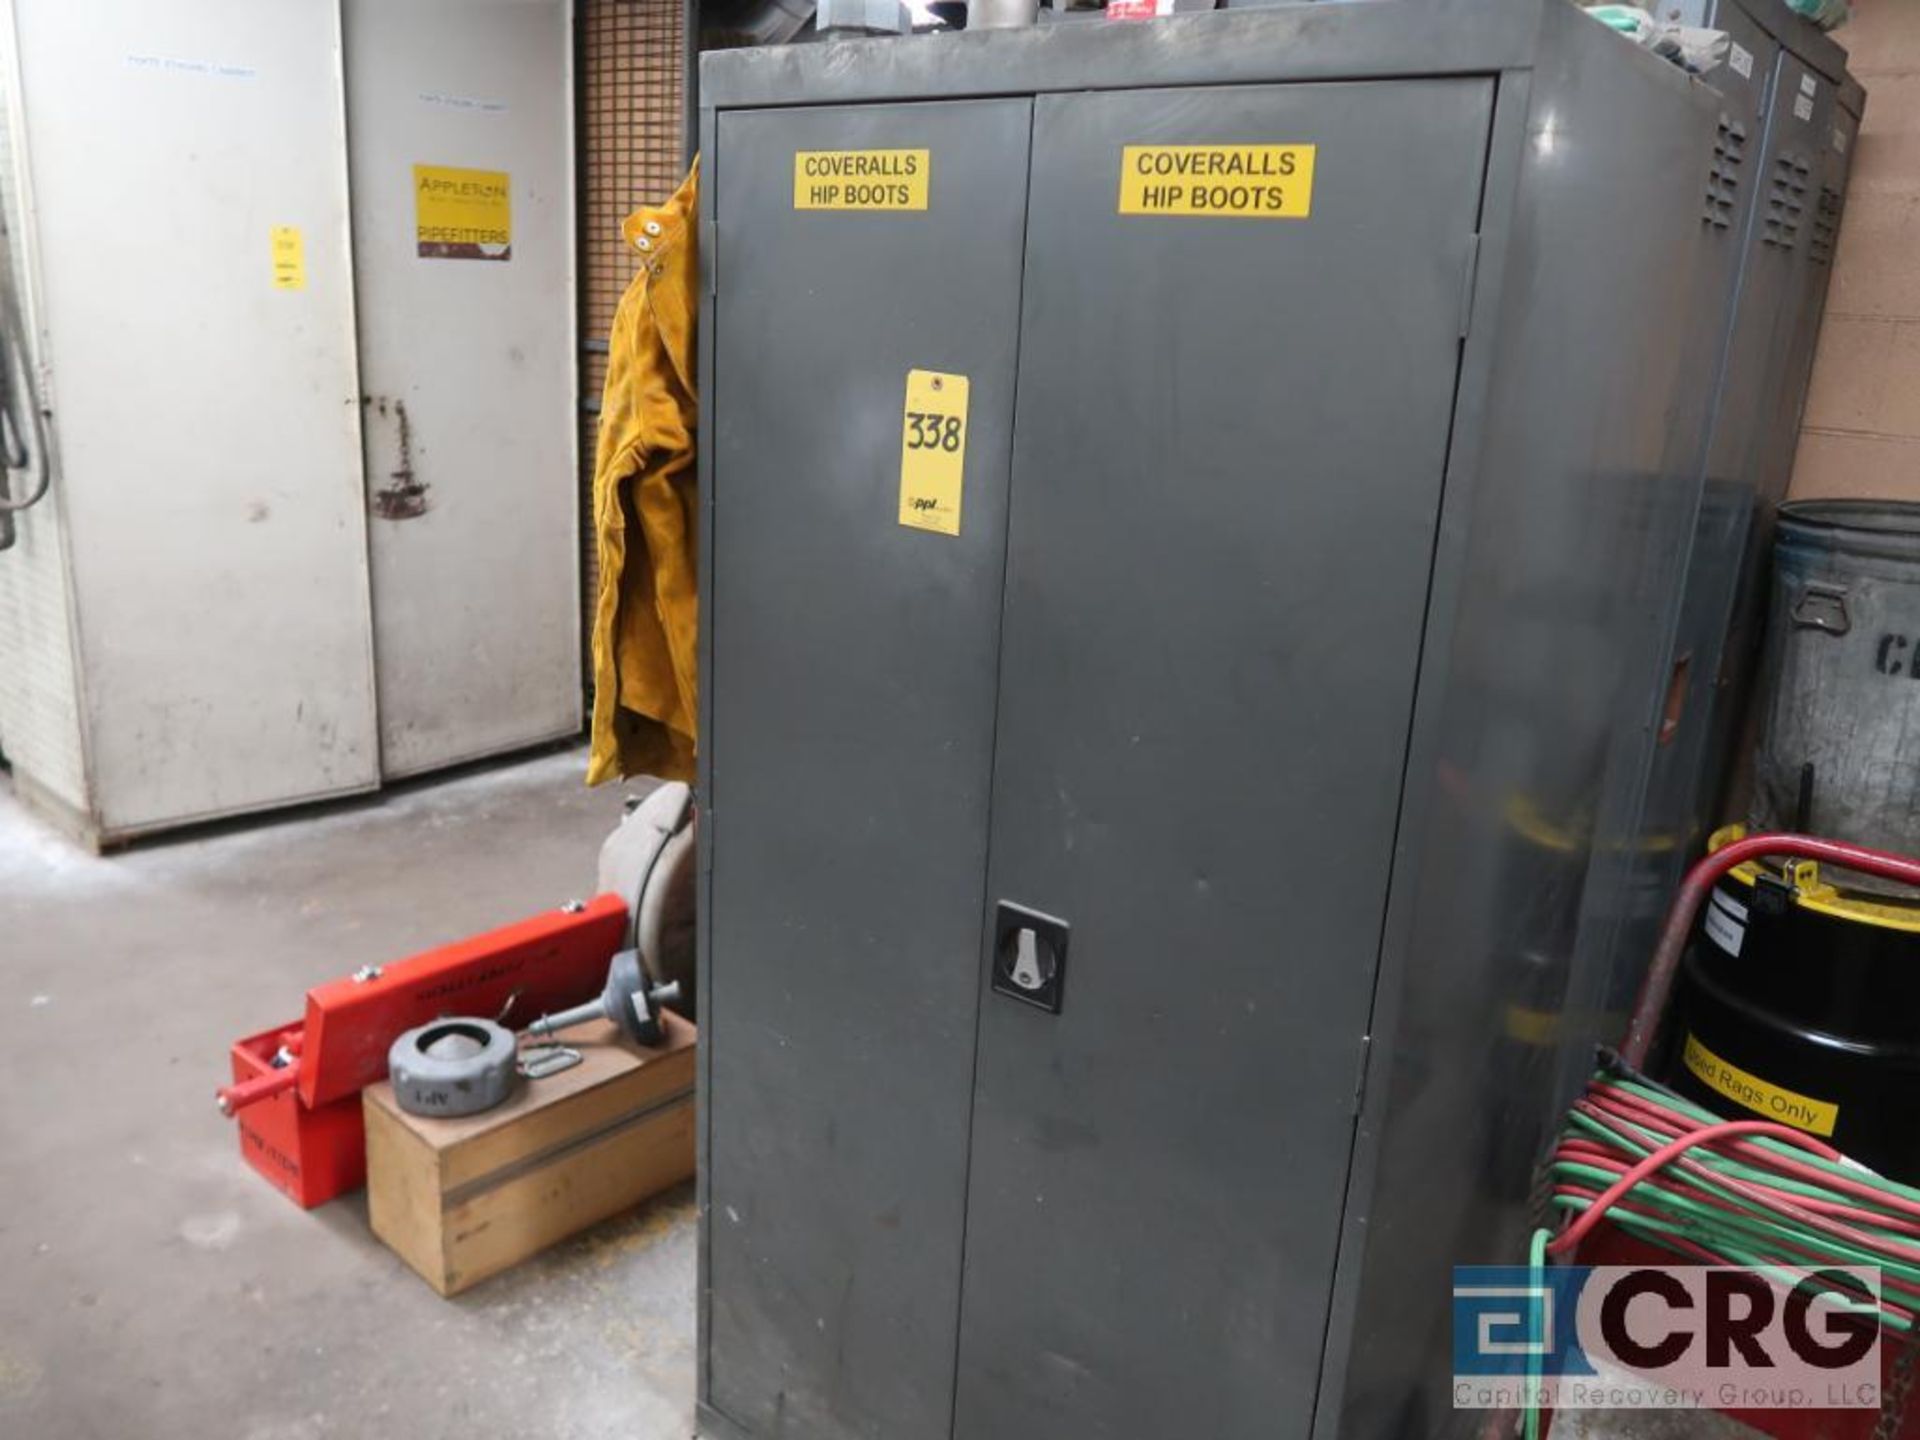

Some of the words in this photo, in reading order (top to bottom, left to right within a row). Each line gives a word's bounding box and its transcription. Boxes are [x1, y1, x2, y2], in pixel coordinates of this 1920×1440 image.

[805, 155, 917, 177] COVERALLS
[1137, 152, 1296, 176] COVERALLS
[810, 185, 839, 205] HIP
[844, 184, 910, 205] BOOTS
[1142, 186, 1183, 208] HIP
[1190, 186, 1284, 210] BOOTS
[418, 225, 508, 244] PIPEFITTERS
[906, 411, 961, 452] 338
[1719, 1069, 1764, 1105] Rags
[1770, 1094, 1818, 1126] Only
